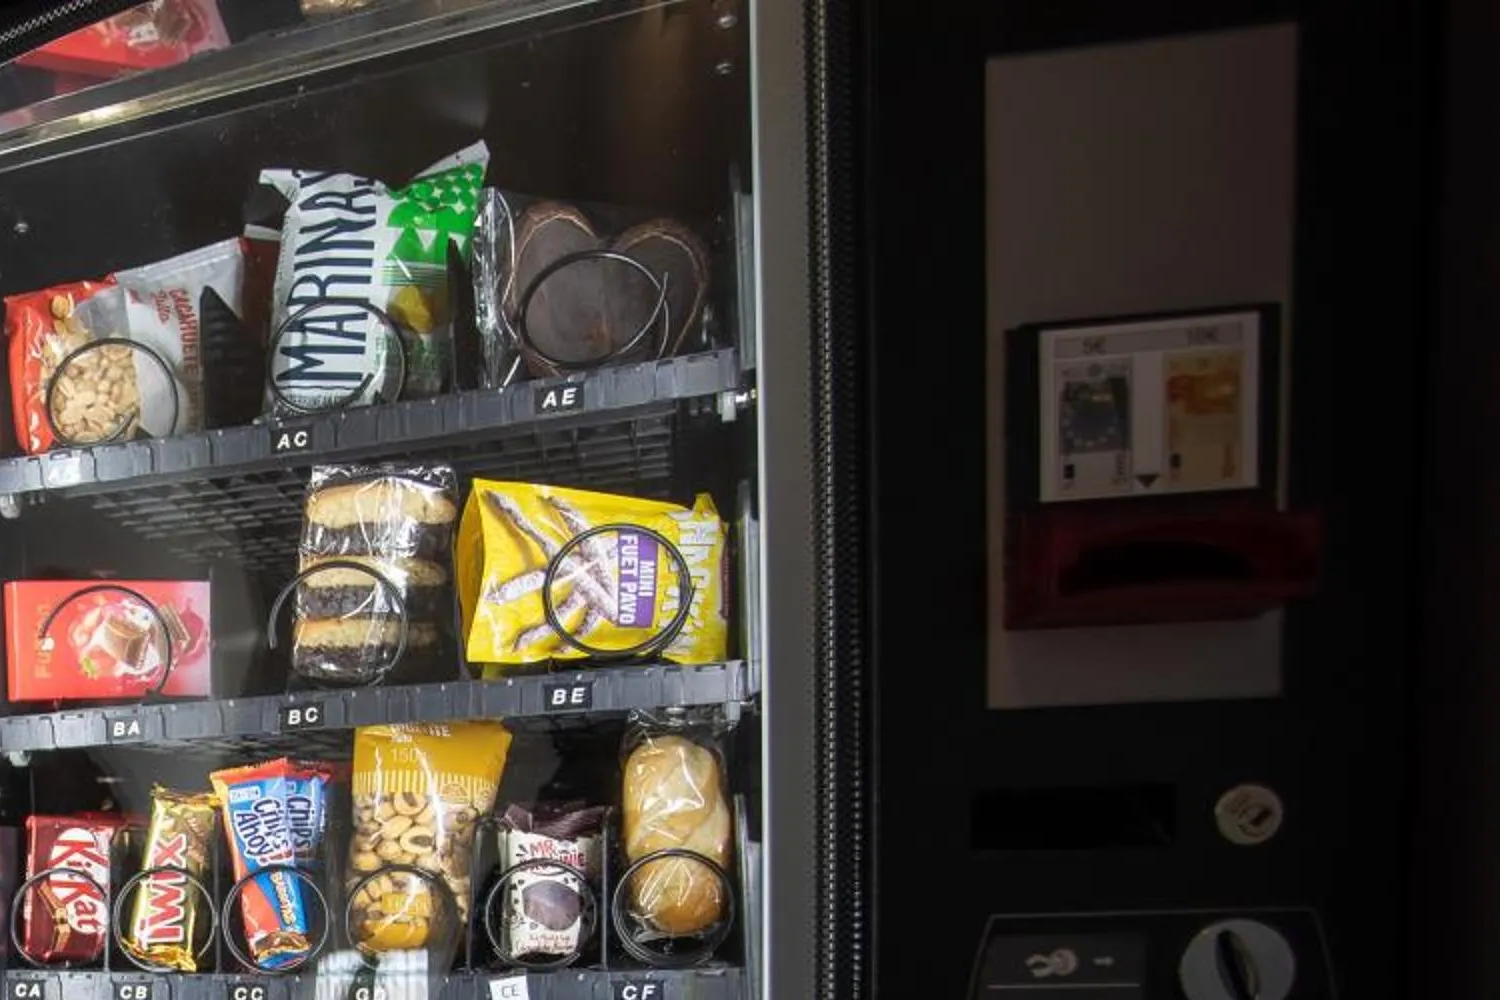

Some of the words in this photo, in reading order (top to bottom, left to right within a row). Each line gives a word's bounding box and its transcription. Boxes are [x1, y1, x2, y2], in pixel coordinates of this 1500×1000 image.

[542, 391, 576, 406] AE
[277, 431, 308, 450] AC
[620, 534, 638, 577] FUET
[639, 559, 655, 597] MINI
[619, 581, 637, 626] PAVO
[552, 689, 586, 704] BE
[288, 709, 319, 725] BC
[113, 720, 141, 737] BA
[48, 838, 107, 935] KitKat
[15, 983, 41, 998] CA
[120, 986, 148, 1000] CB
[622, 986, 655, 1000] CF
